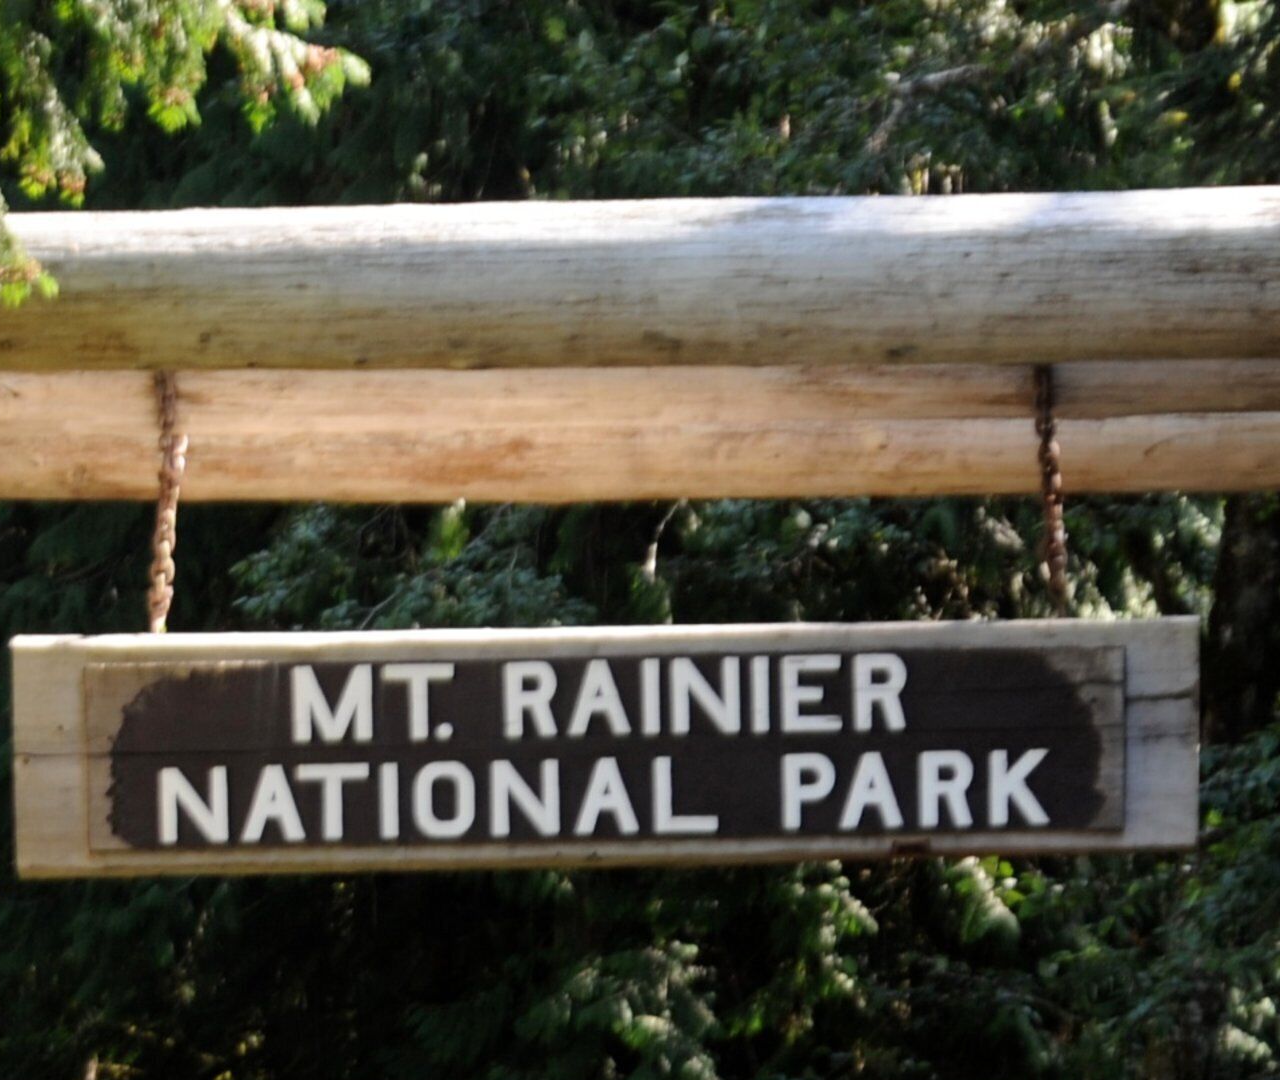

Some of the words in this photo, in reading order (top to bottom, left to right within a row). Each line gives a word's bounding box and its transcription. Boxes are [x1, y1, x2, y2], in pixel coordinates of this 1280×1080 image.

[291, 663, 455, 743] MT.
[502, 652, 908, 741] RAINIER
[157, 755, 720, 844] NATIONAL
[781, 748, 1051, 832] PARK
